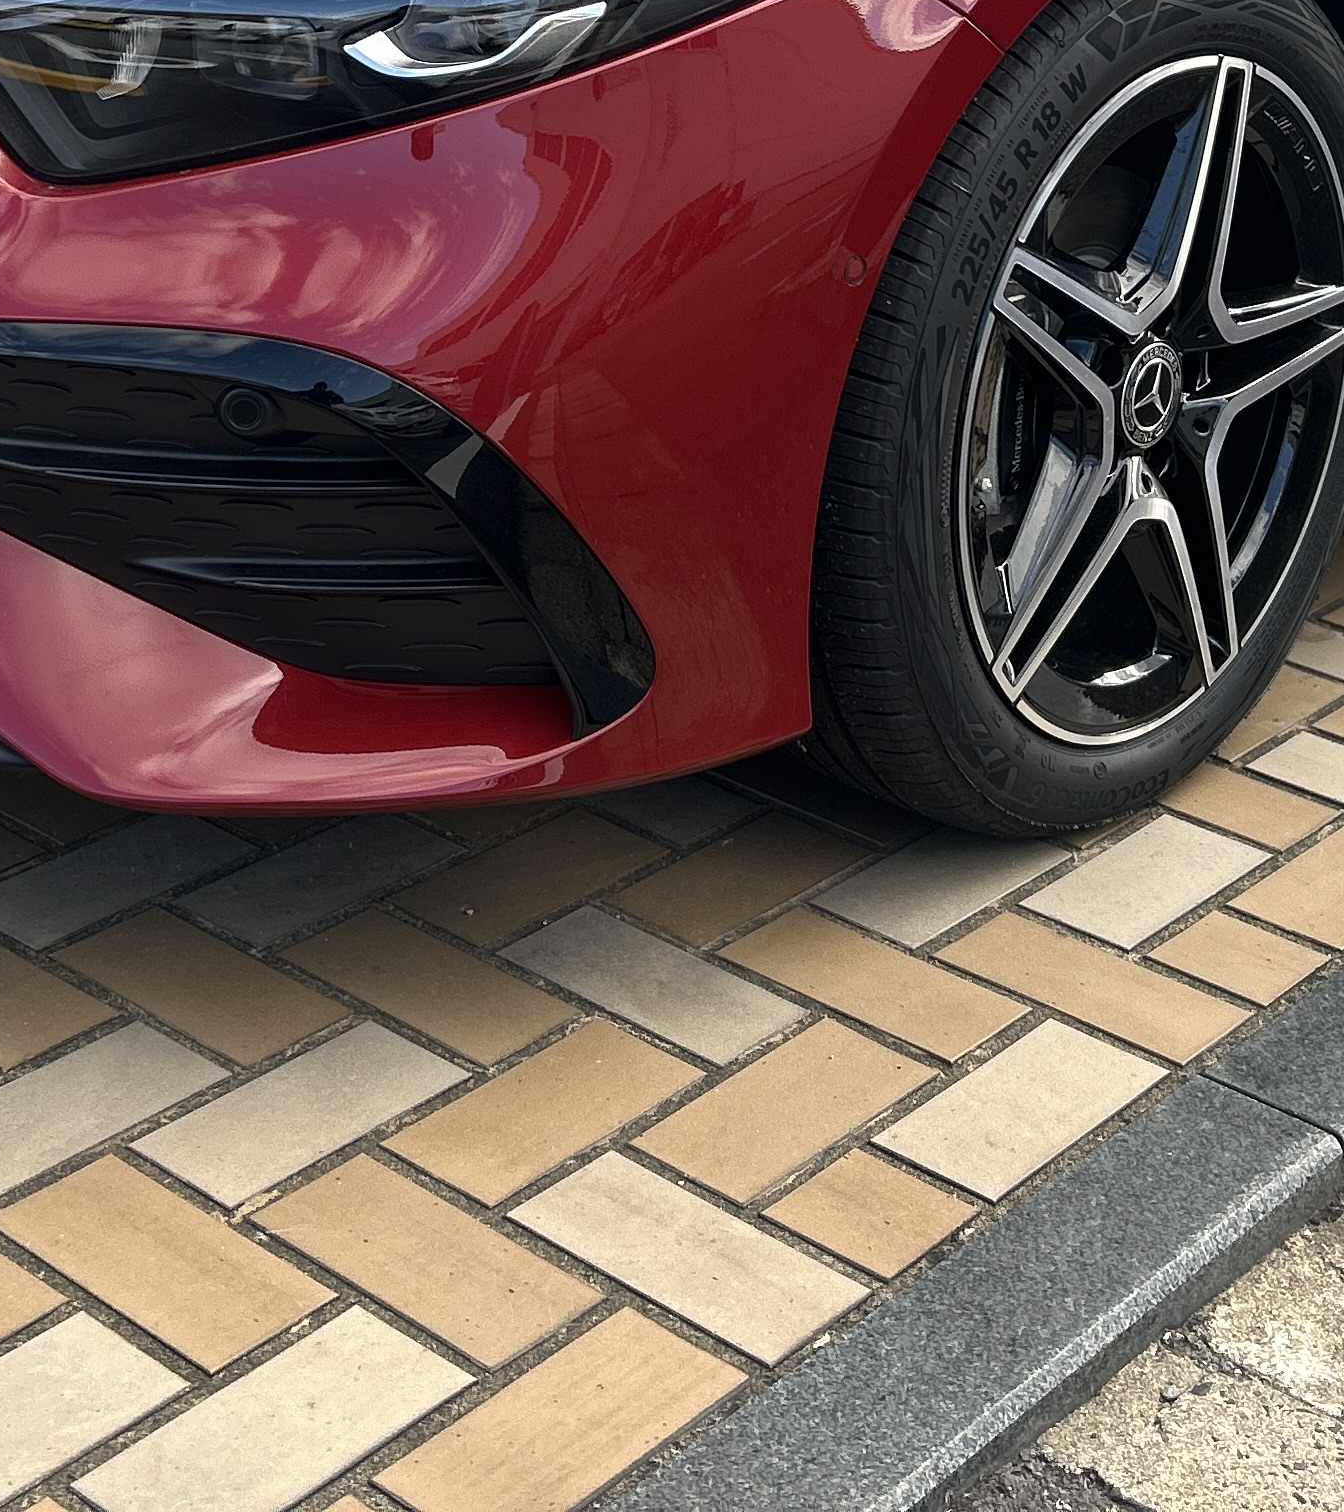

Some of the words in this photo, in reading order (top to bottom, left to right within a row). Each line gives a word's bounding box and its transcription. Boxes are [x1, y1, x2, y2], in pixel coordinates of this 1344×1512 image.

[951, 169, 1018, 307] 225/45
[1013, 139, 1038, 171] R
[1031, 100, 1062, 142] 18
[1059, 62, 1088, 104] W
[1011, 373, 1026, 473] Mercedes-Ben
